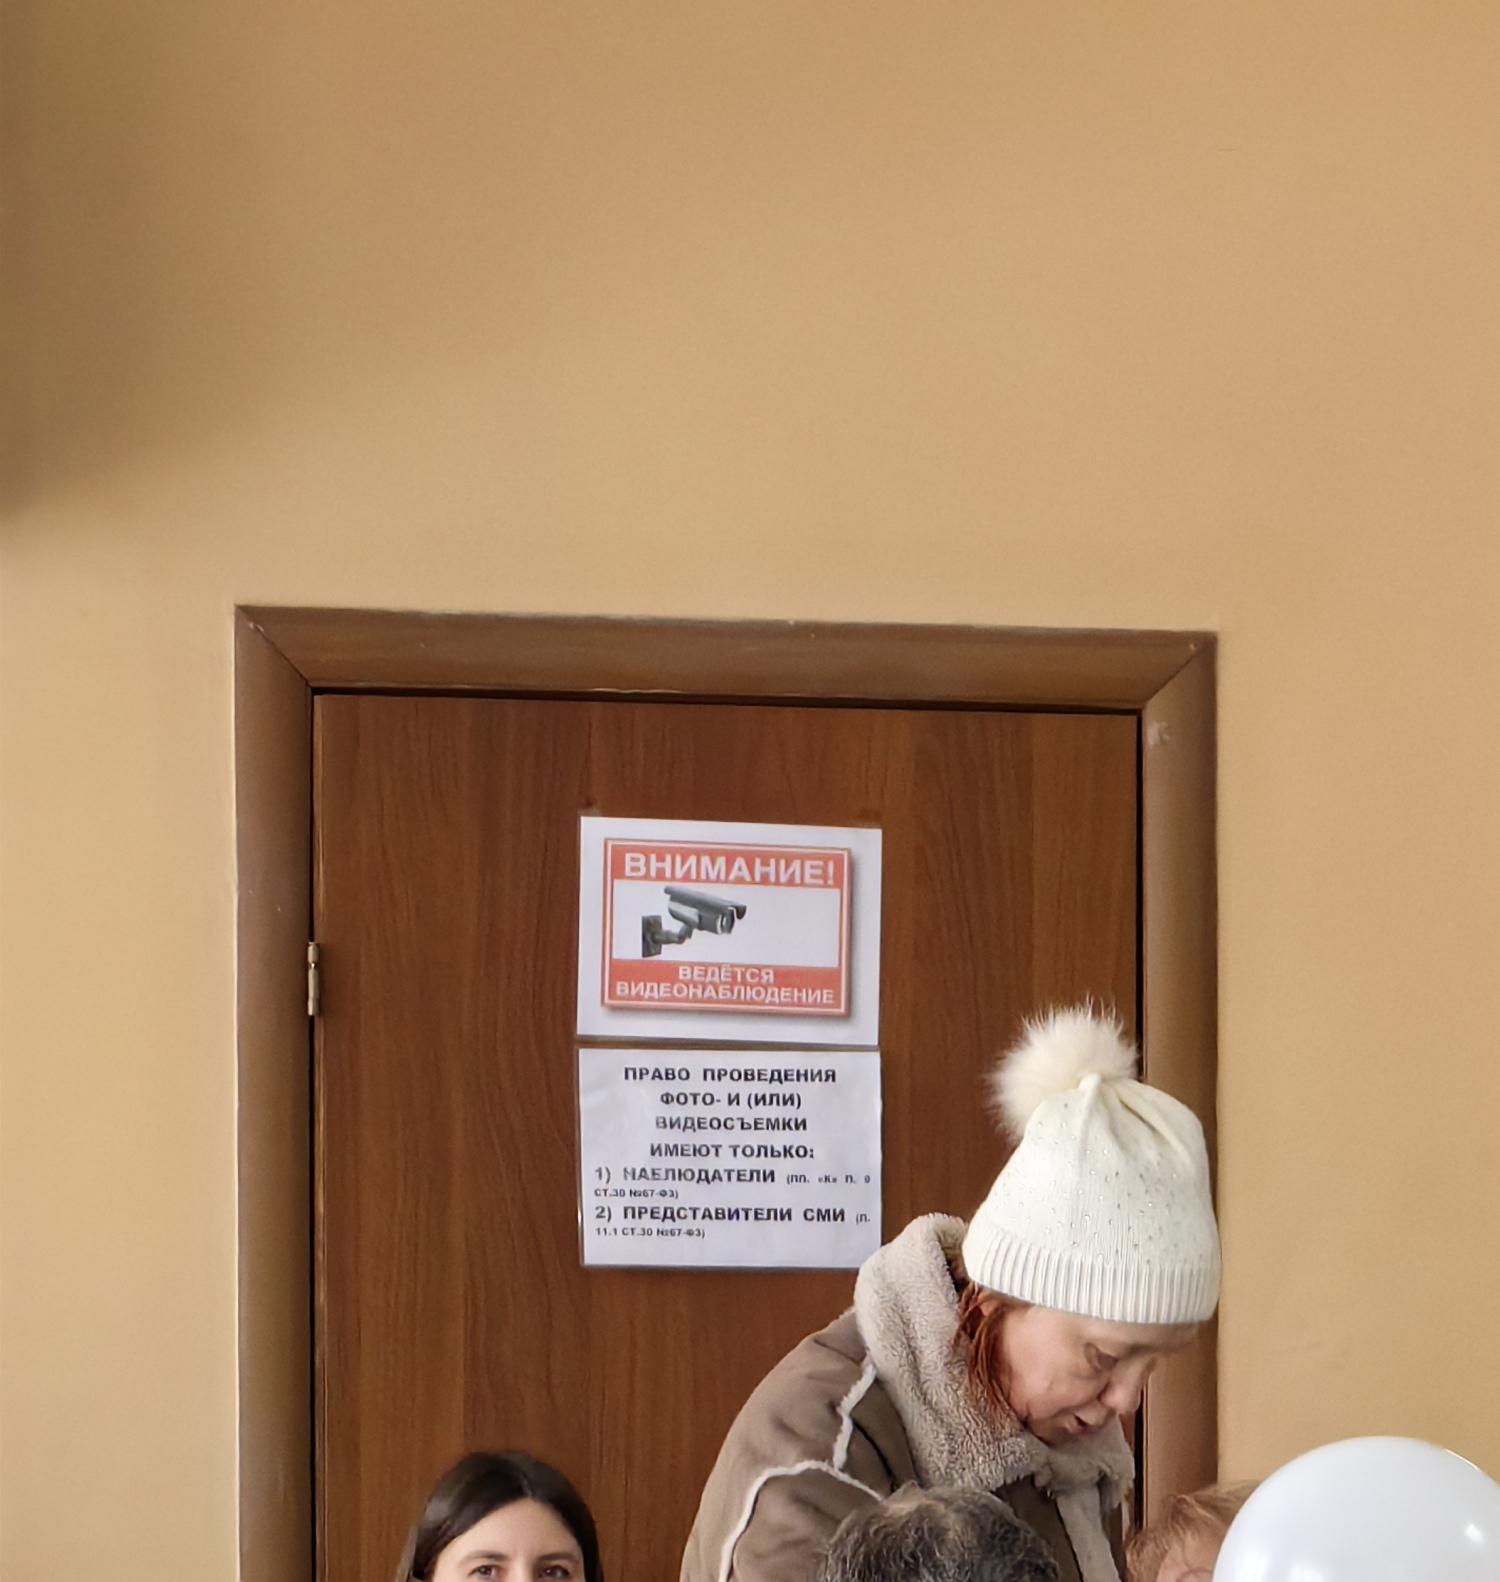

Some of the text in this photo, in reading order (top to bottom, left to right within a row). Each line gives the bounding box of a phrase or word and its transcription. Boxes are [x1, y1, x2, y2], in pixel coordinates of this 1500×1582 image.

[624, 852, 834, 885] ВНИМАНИЕ!
[678, 963, 774, 985] ВЕДЁТСЯ
[616, 981, 834, 1005] ВИДЕОНАБЛЮДЕНИЕ
[624, 1066, 837, 1085] ПРАВО ПРОВЕДЕНИЯ
[660, 1091, 802, 1110] ФОТО- И (ИЛИ)
[655, 1116, 808, 1133] ВИДЕОСЪЕМКИ
[650, 1143, 815, 1159] ИМЕЮТ ТОЛЬКО:
[594, 1166, 612, 1185] 1)
[595, 1205, 612, 1223] 2)
[623, 1206, 793, 1223] ПРЕДСТАВИТЕЛИ
[802, 1207, 846, 1223] СМИ
